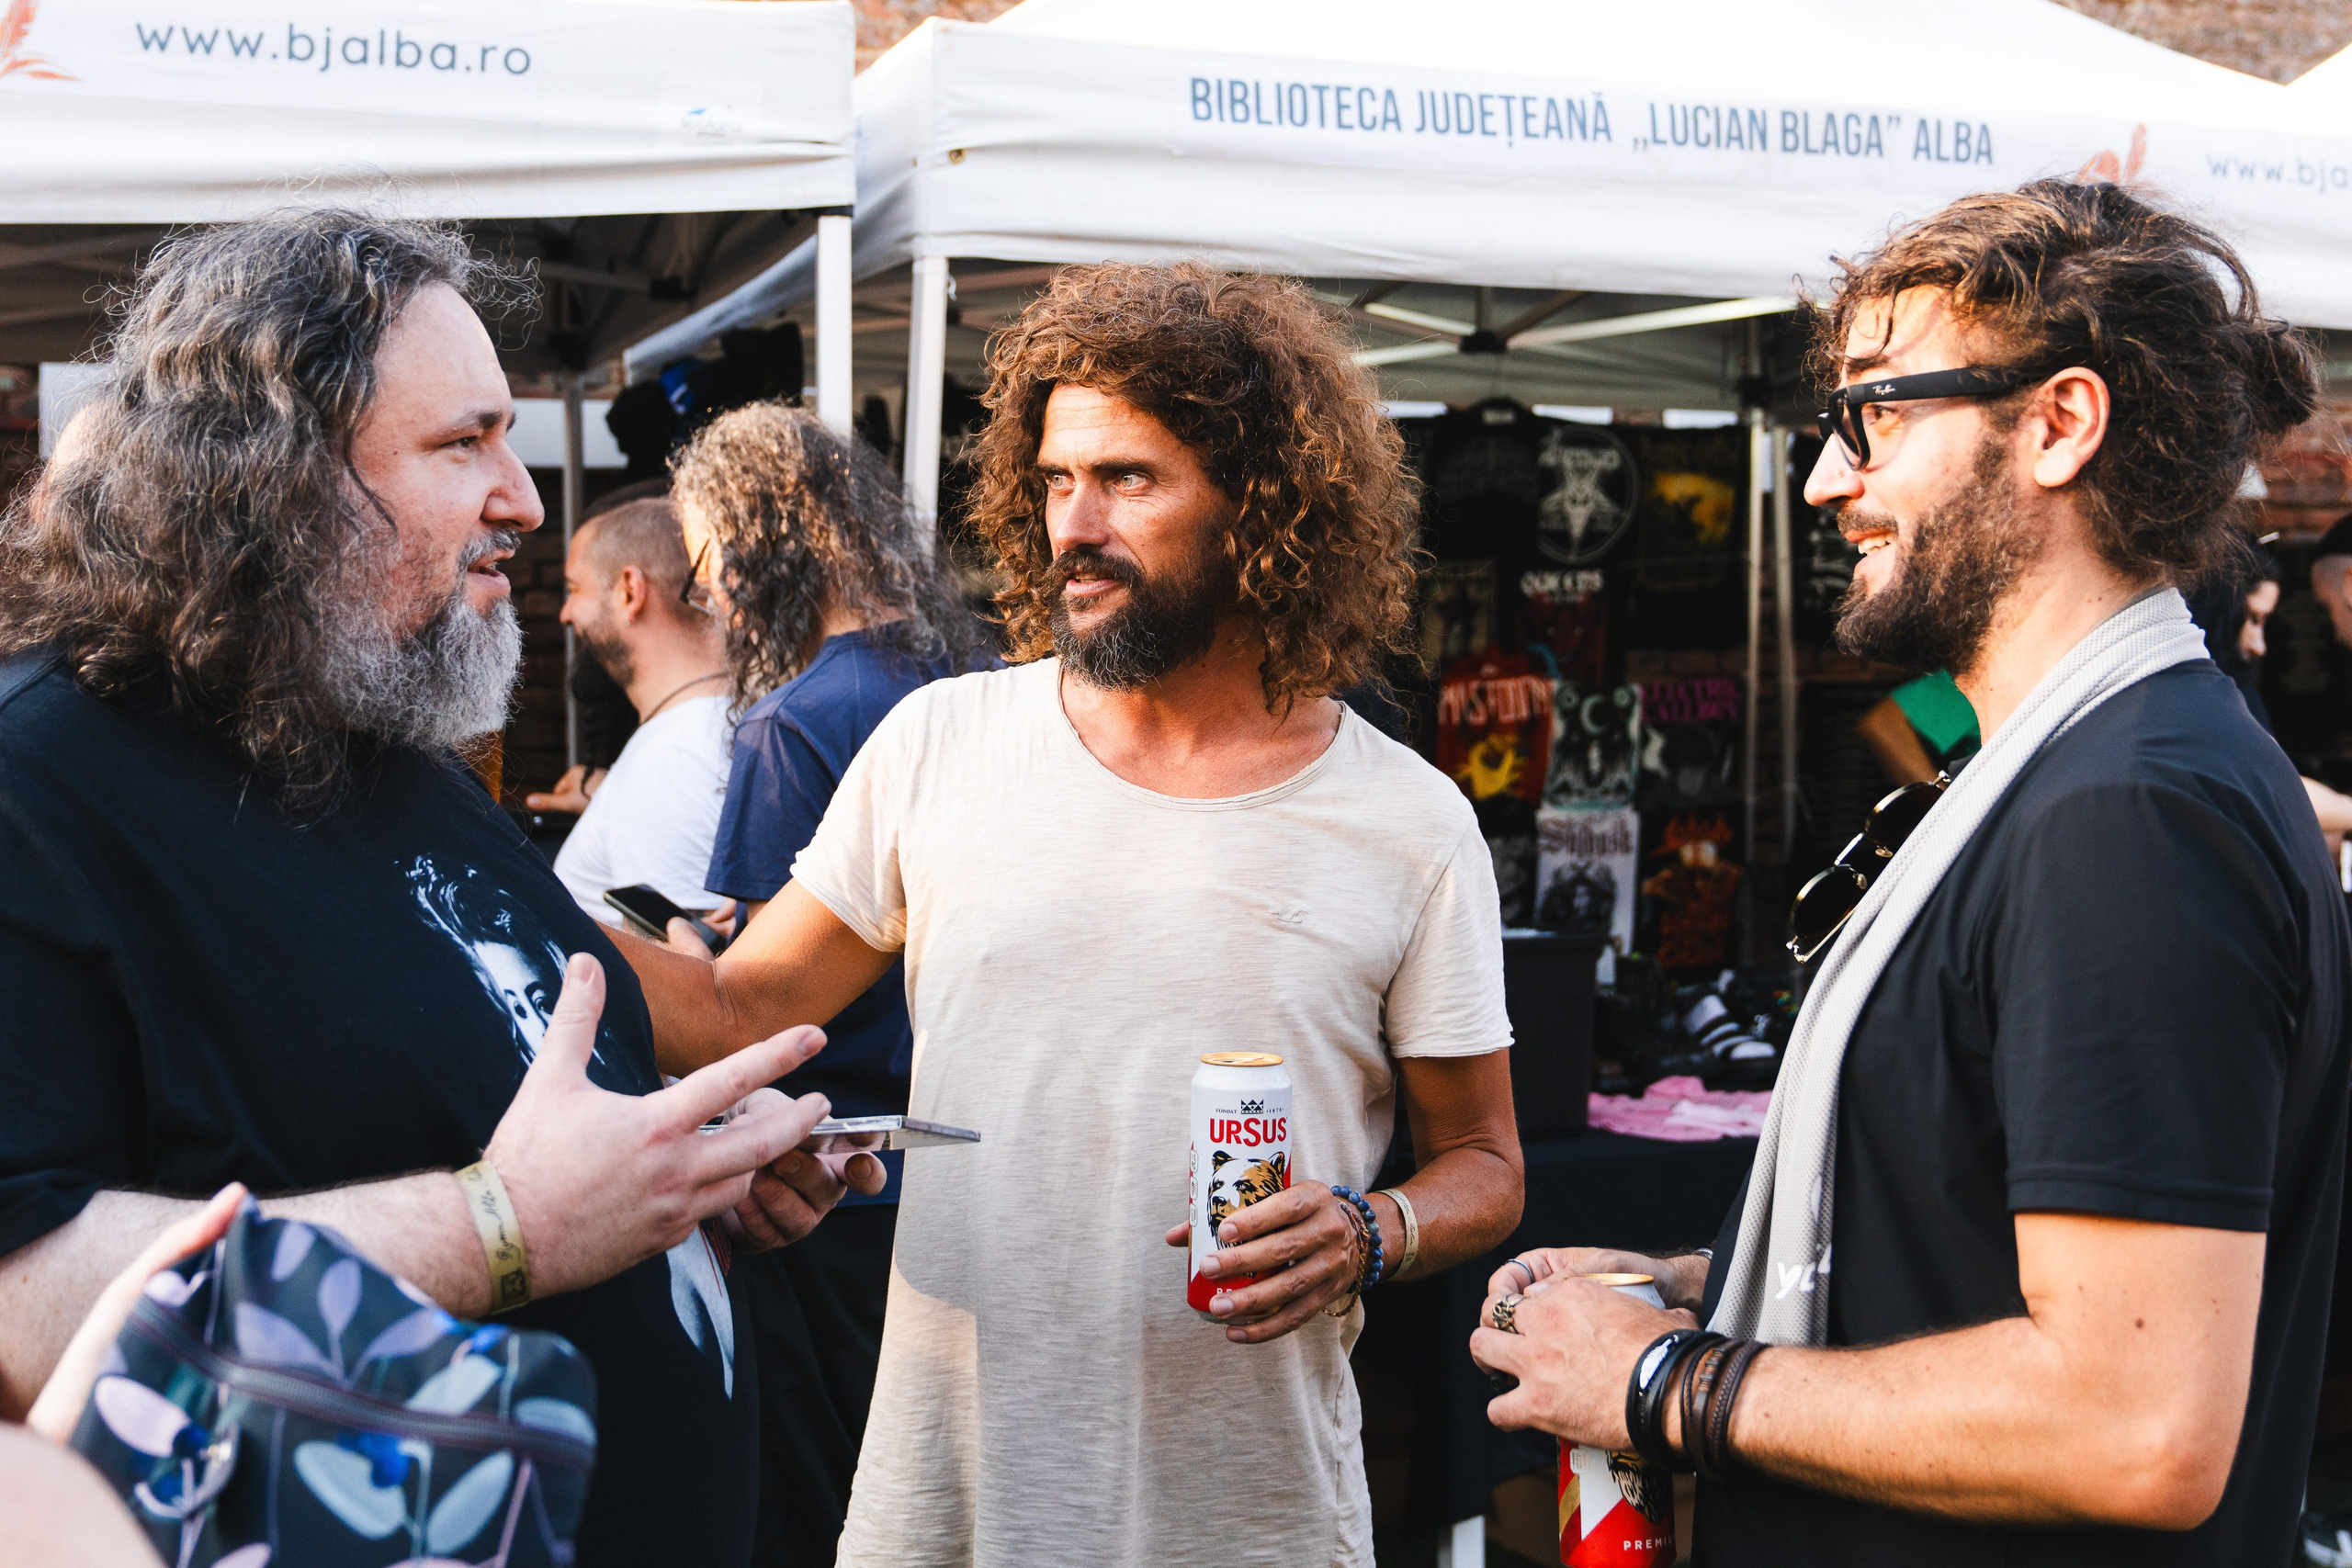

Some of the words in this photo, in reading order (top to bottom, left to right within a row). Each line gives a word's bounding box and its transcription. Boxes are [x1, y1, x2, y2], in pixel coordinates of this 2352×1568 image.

[135, 22, 532, 76] www.bjalba.ro
[1189, 75, 1403, 133] BIBLIOTECA
[1414, 89, 1613, 149] JUDEȚEANĂ
[1912, 117, 1994, 165] ALBA
[2206, 154, 2352, 194] www.bja
[1209, 1117, 1287, 1147] URSUS
[1623, 1535, 1673, 1551] PREMIU
